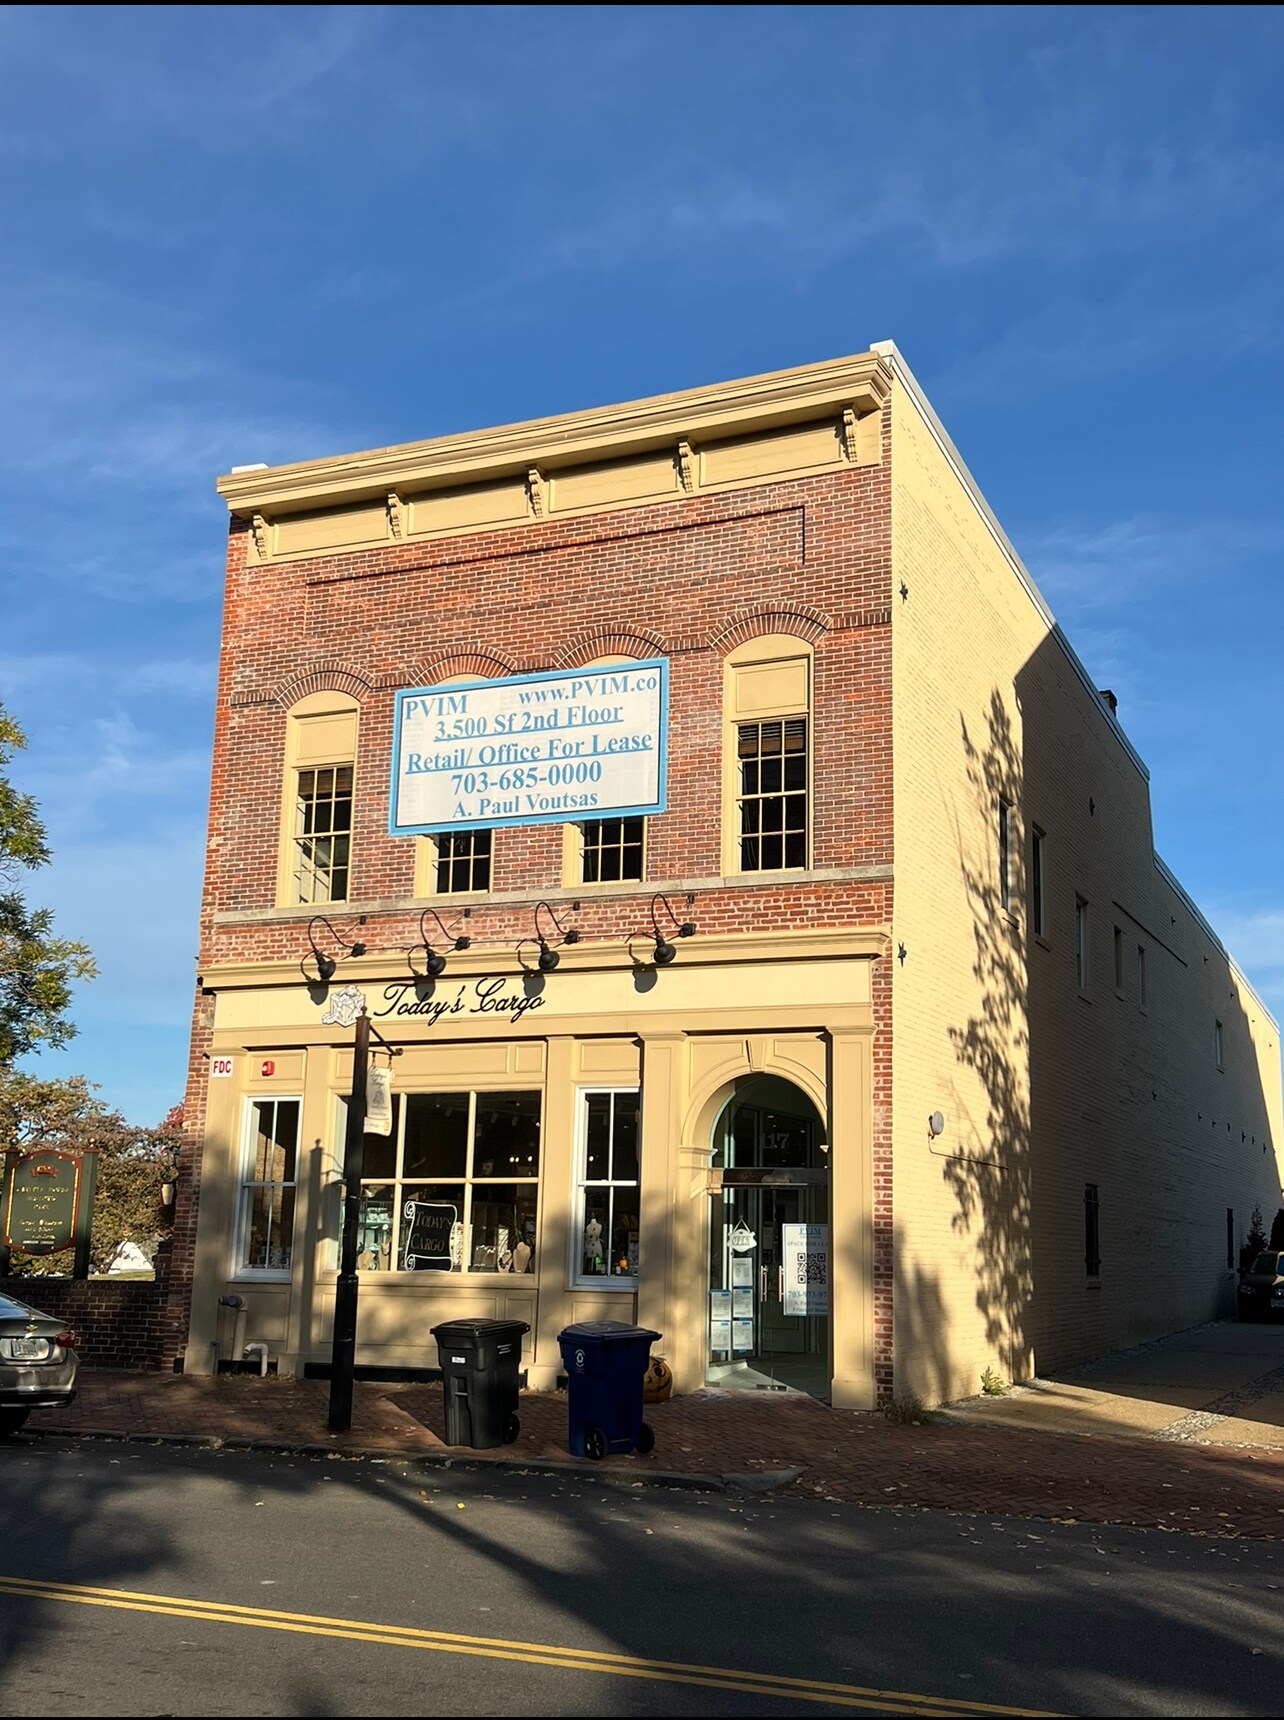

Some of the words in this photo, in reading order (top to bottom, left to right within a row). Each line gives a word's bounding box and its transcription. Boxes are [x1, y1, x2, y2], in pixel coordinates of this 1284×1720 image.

[518, 675, 658, 705] www.PVIM.co
[404, 694, 468, 720] PVIM
[436, 717, 488, 740] 3,500
[493, 713, 517, 734] Sf
[521, 708, 559, 732] 2nd
[567, 703, 624, 726] Floor
[407, 747, 473, 772] Retail/
[478, 742, 541, 766] Office
[548, 737, 585, 759] For
[592, 732, 653, 754] Lease
[451, 760, 602, 796] 703-685-0000
[452, 801, 472, 818] A.
[479, 795, 520, 816] Paul
[526, 791, 599, 812] Voutsas
[373, 982, 466, 1026] Today's
[470, 977, 546, 1024] Cargo
[213, 1060, 232, 1074] FDC
[410, 1233, 446, 1252] CARGO
